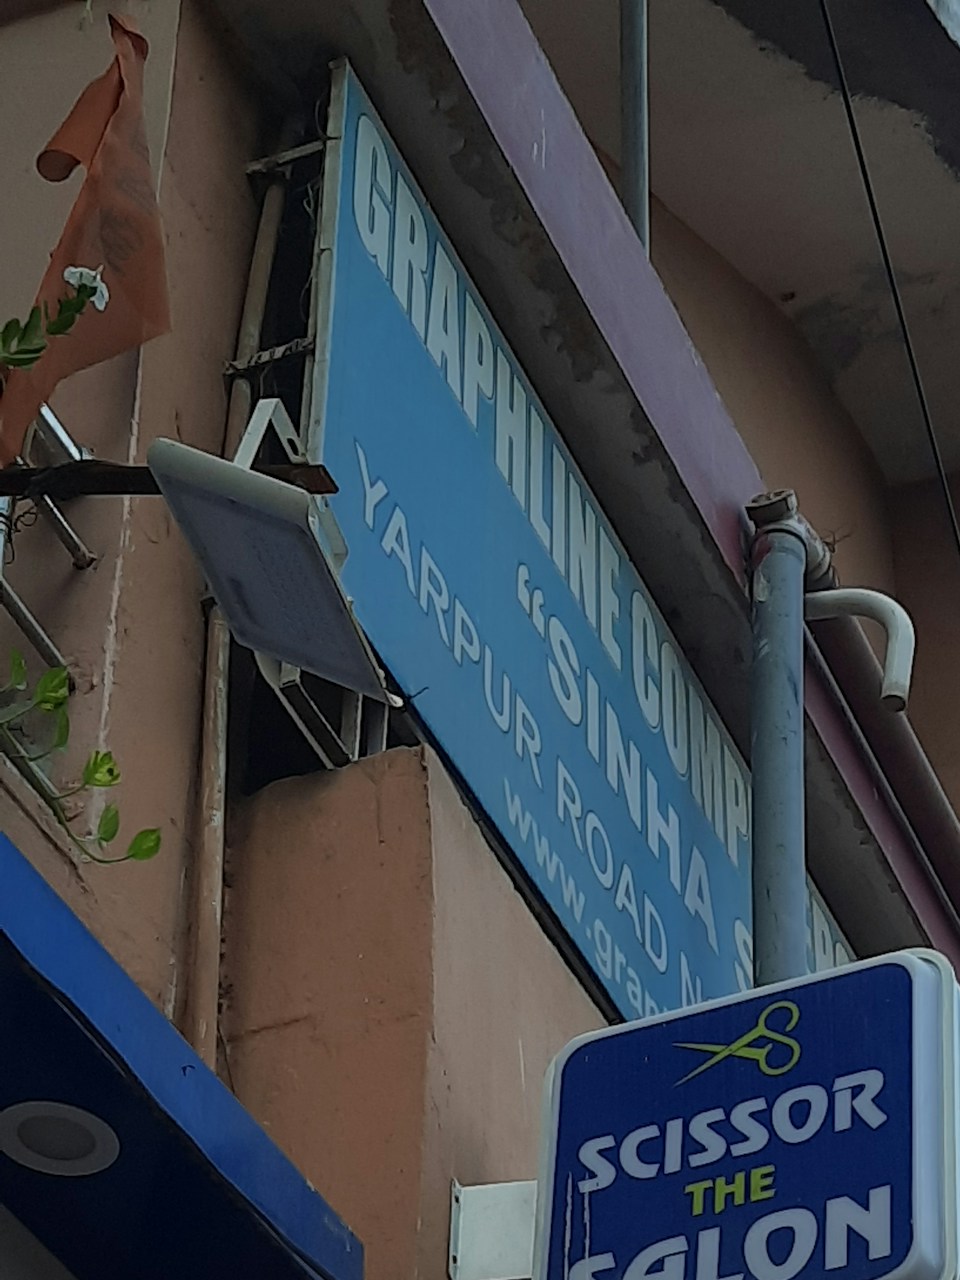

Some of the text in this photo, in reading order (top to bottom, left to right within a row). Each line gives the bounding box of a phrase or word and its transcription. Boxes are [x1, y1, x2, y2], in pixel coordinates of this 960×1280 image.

[353, 114, 622, 673] GRAPHLINE
[353, 438, 542, 789] YARPUR
[556, 764, 668, 974] ROAD
[577, 1068, 889, 1194] SCISSOR
[684, 1164, 777, 1217] THE
